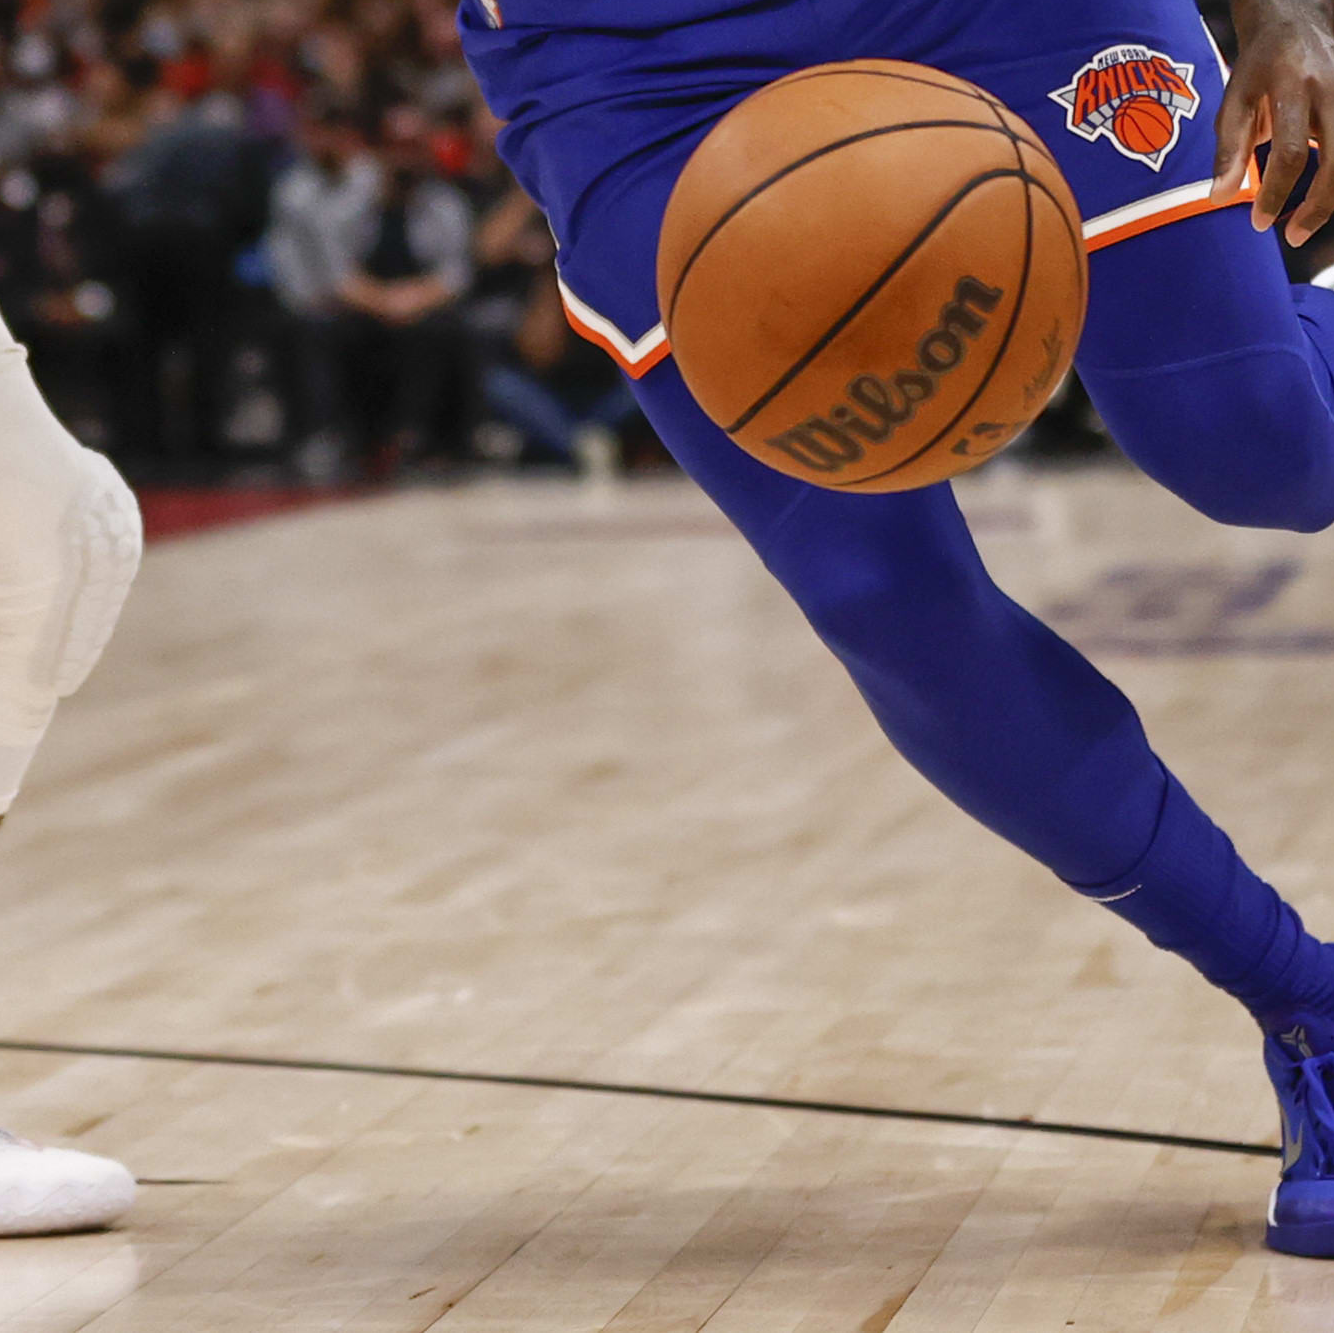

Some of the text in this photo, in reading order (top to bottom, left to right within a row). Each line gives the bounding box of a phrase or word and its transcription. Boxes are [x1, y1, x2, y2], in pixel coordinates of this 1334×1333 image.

[1072, 55, 1196, 127] KNICKS
[1098, 48, 1149, 69] NEW YORK
[767, 275, 1003, 471] Wilson
